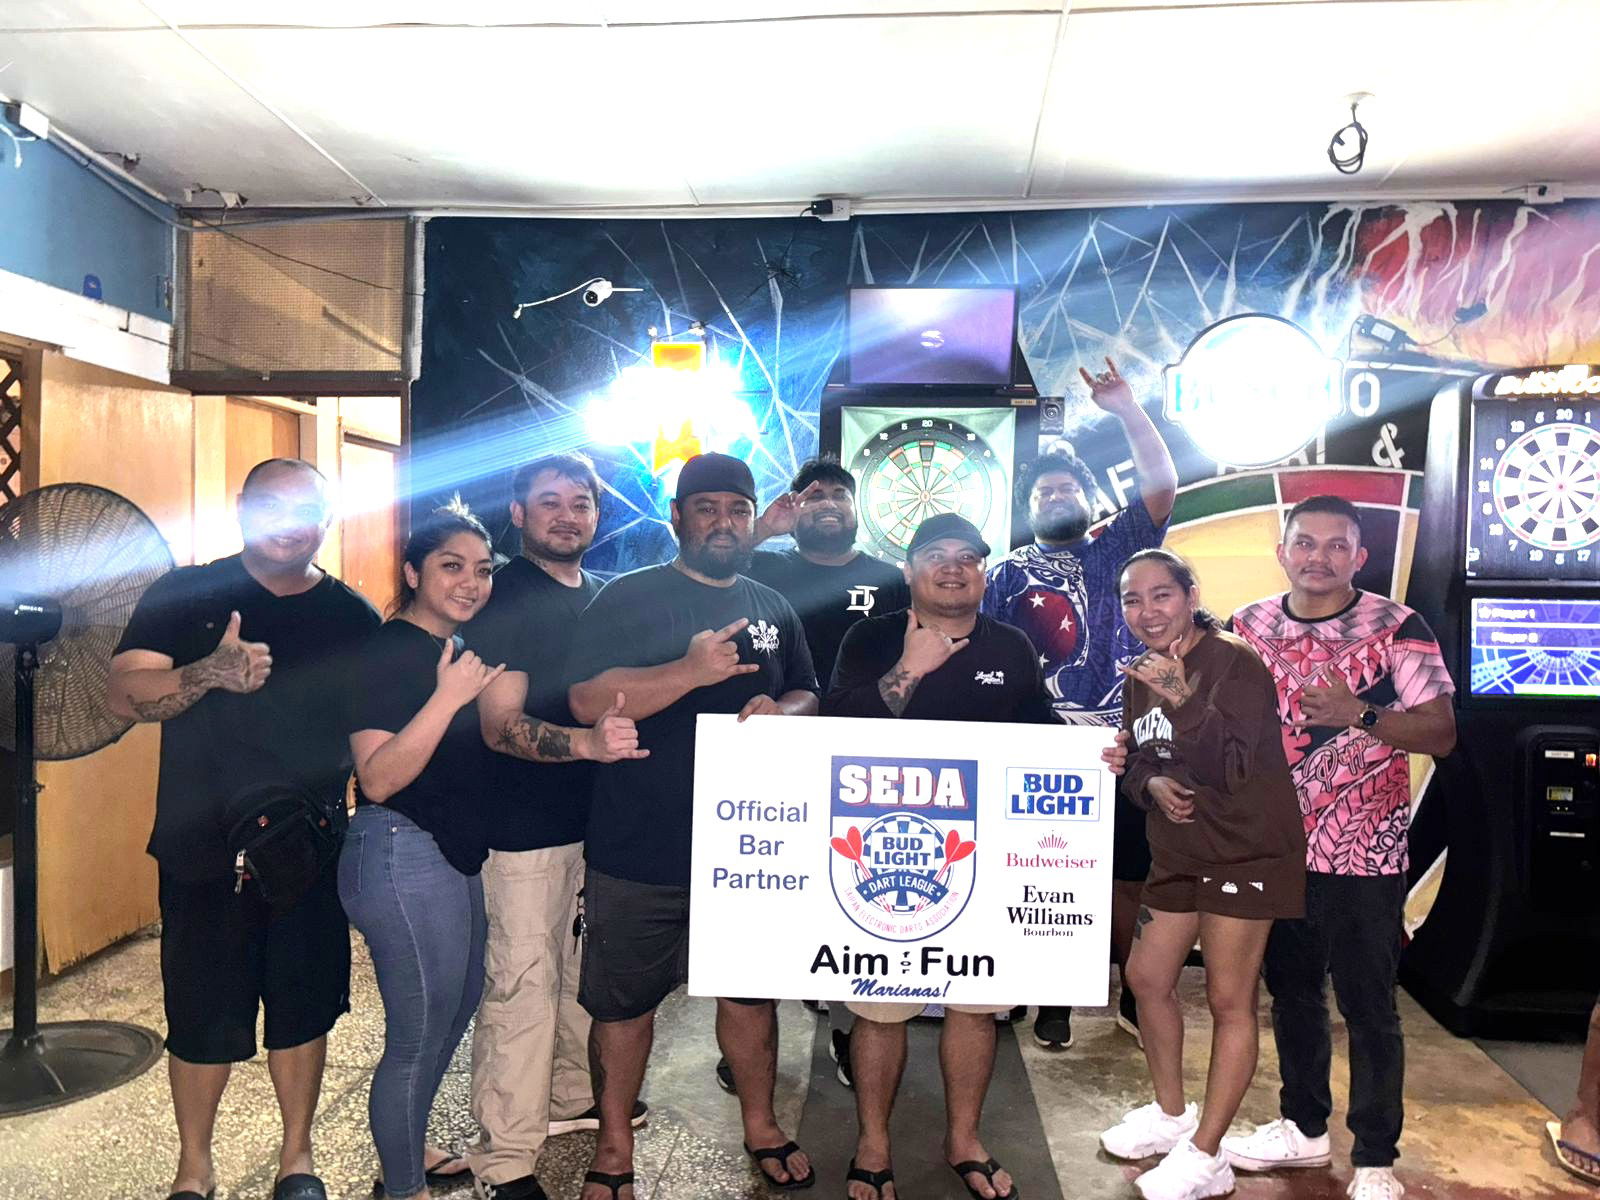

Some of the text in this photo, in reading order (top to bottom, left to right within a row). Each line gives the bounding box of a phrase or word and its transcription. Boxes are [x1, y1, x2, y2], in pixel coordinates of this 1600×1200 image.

[922, 420, 933, 428] 20
[1556, 409, 1573, 421] 20
[1585, 412, 1591, 423] 1
[1509, 540, 1518, 551] 7
[1577, 549, 1591, 561] 17
[839, 764, 968, 809] SEDA
[1024, 773, 1084, 794] BUD
[716, 800, 808, 822] Official
[1011, 795, 1094, 815] LIGHT
[739, 834, 785, 856] Bar
[882, 837, 923, 851] BUD
[874, 851, 931, 866] LIGHT
[1006, 852, 1097, 869] Budweiser
[713, 867, 809, 891] Partner
[868, 875, 938, 895] DART LEAGUE
[1022, 885, 1075, 904] Evan
[858, 907, 897, 934] ELECTRONIC
[900, 922, 923, 934] DARTS
[925, 891, 960, 927] ASSOCIATION
[1006, 907, 1094, 925] Williams
[1023, 928, 1074, 937] Bourbon
[810, 944, 889, 976] Aim
[921, 946, 995, 977] Fun
[851, 977, 951, 998] Marianas!
